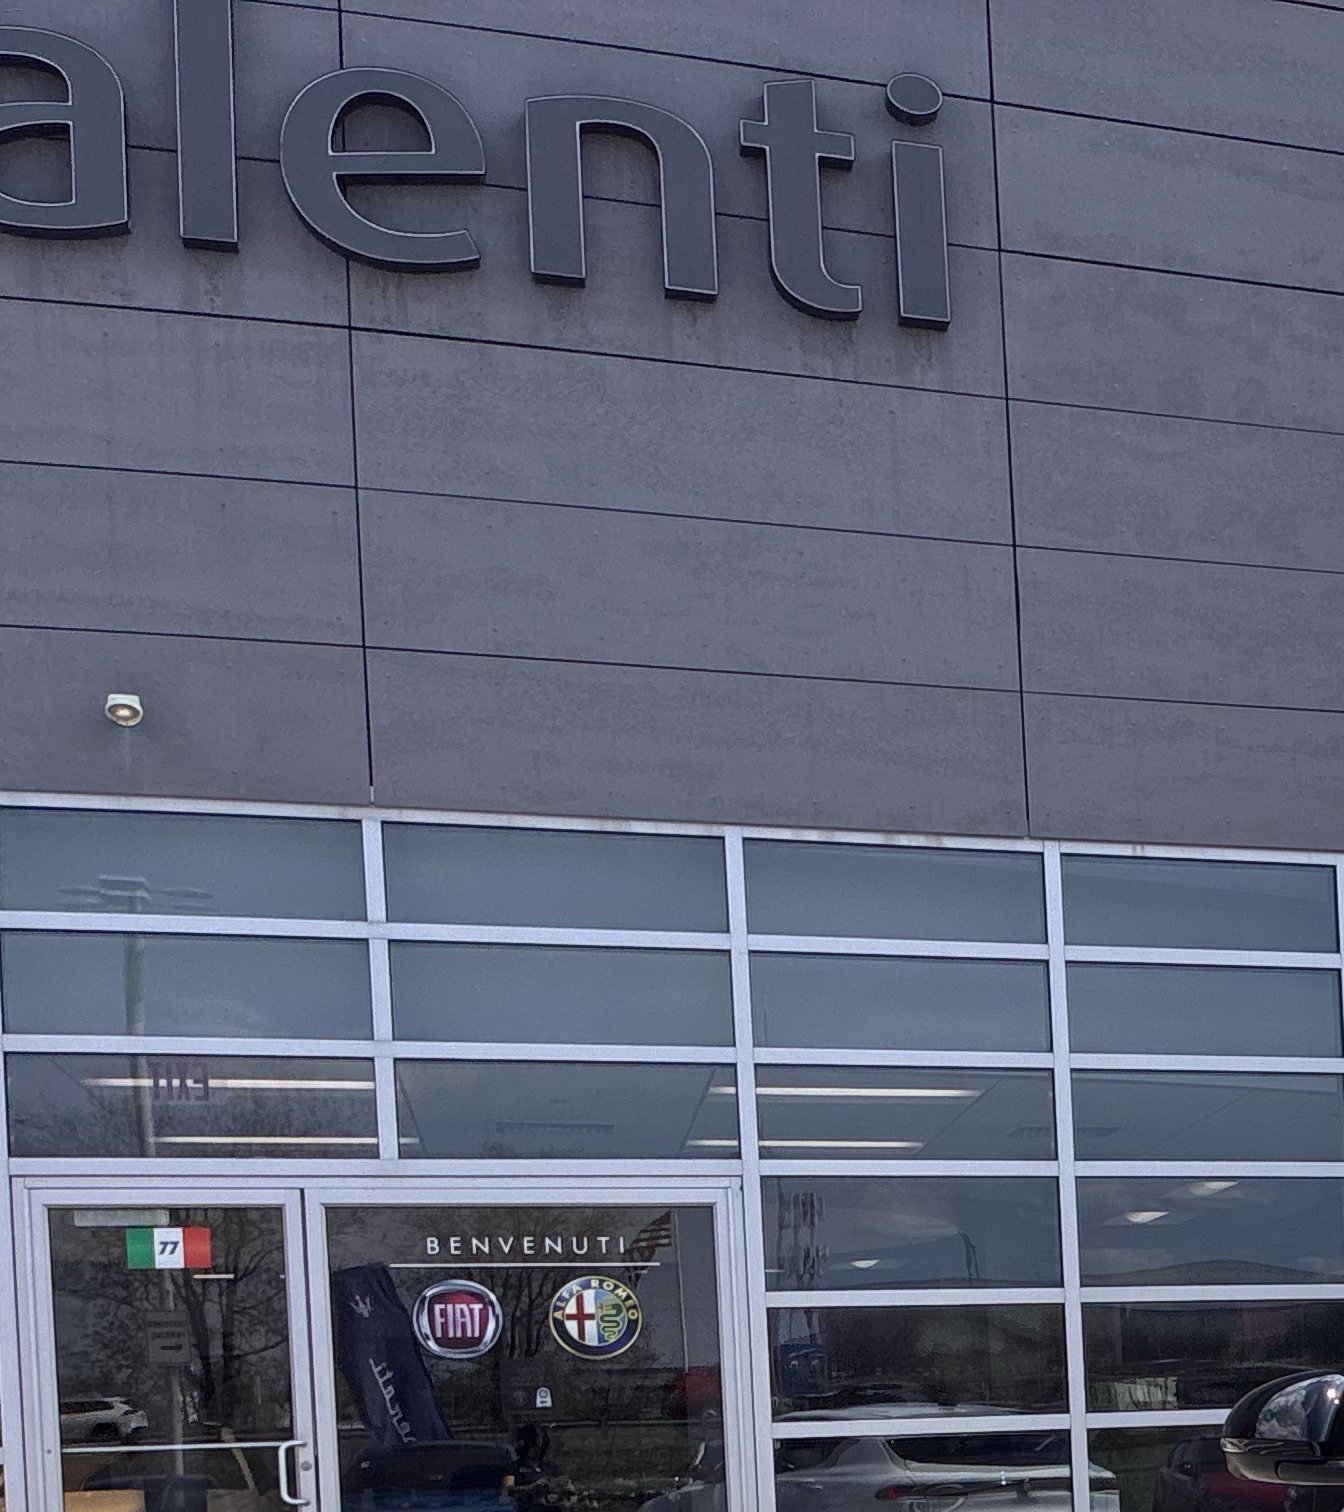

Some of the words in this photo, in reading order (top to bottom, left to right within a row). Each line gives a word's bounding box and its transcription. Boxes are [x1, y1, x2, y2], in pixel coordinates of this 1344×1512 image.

[157, 1241, 180, 1255] 77
[426, 1235, 625, 1255] BENVENUTI
[553, 1284, 583, 1321] ALFA
[590, 1279, 639, 1320] ROMEO
[433, 1303, 484, 1338] FIAT
